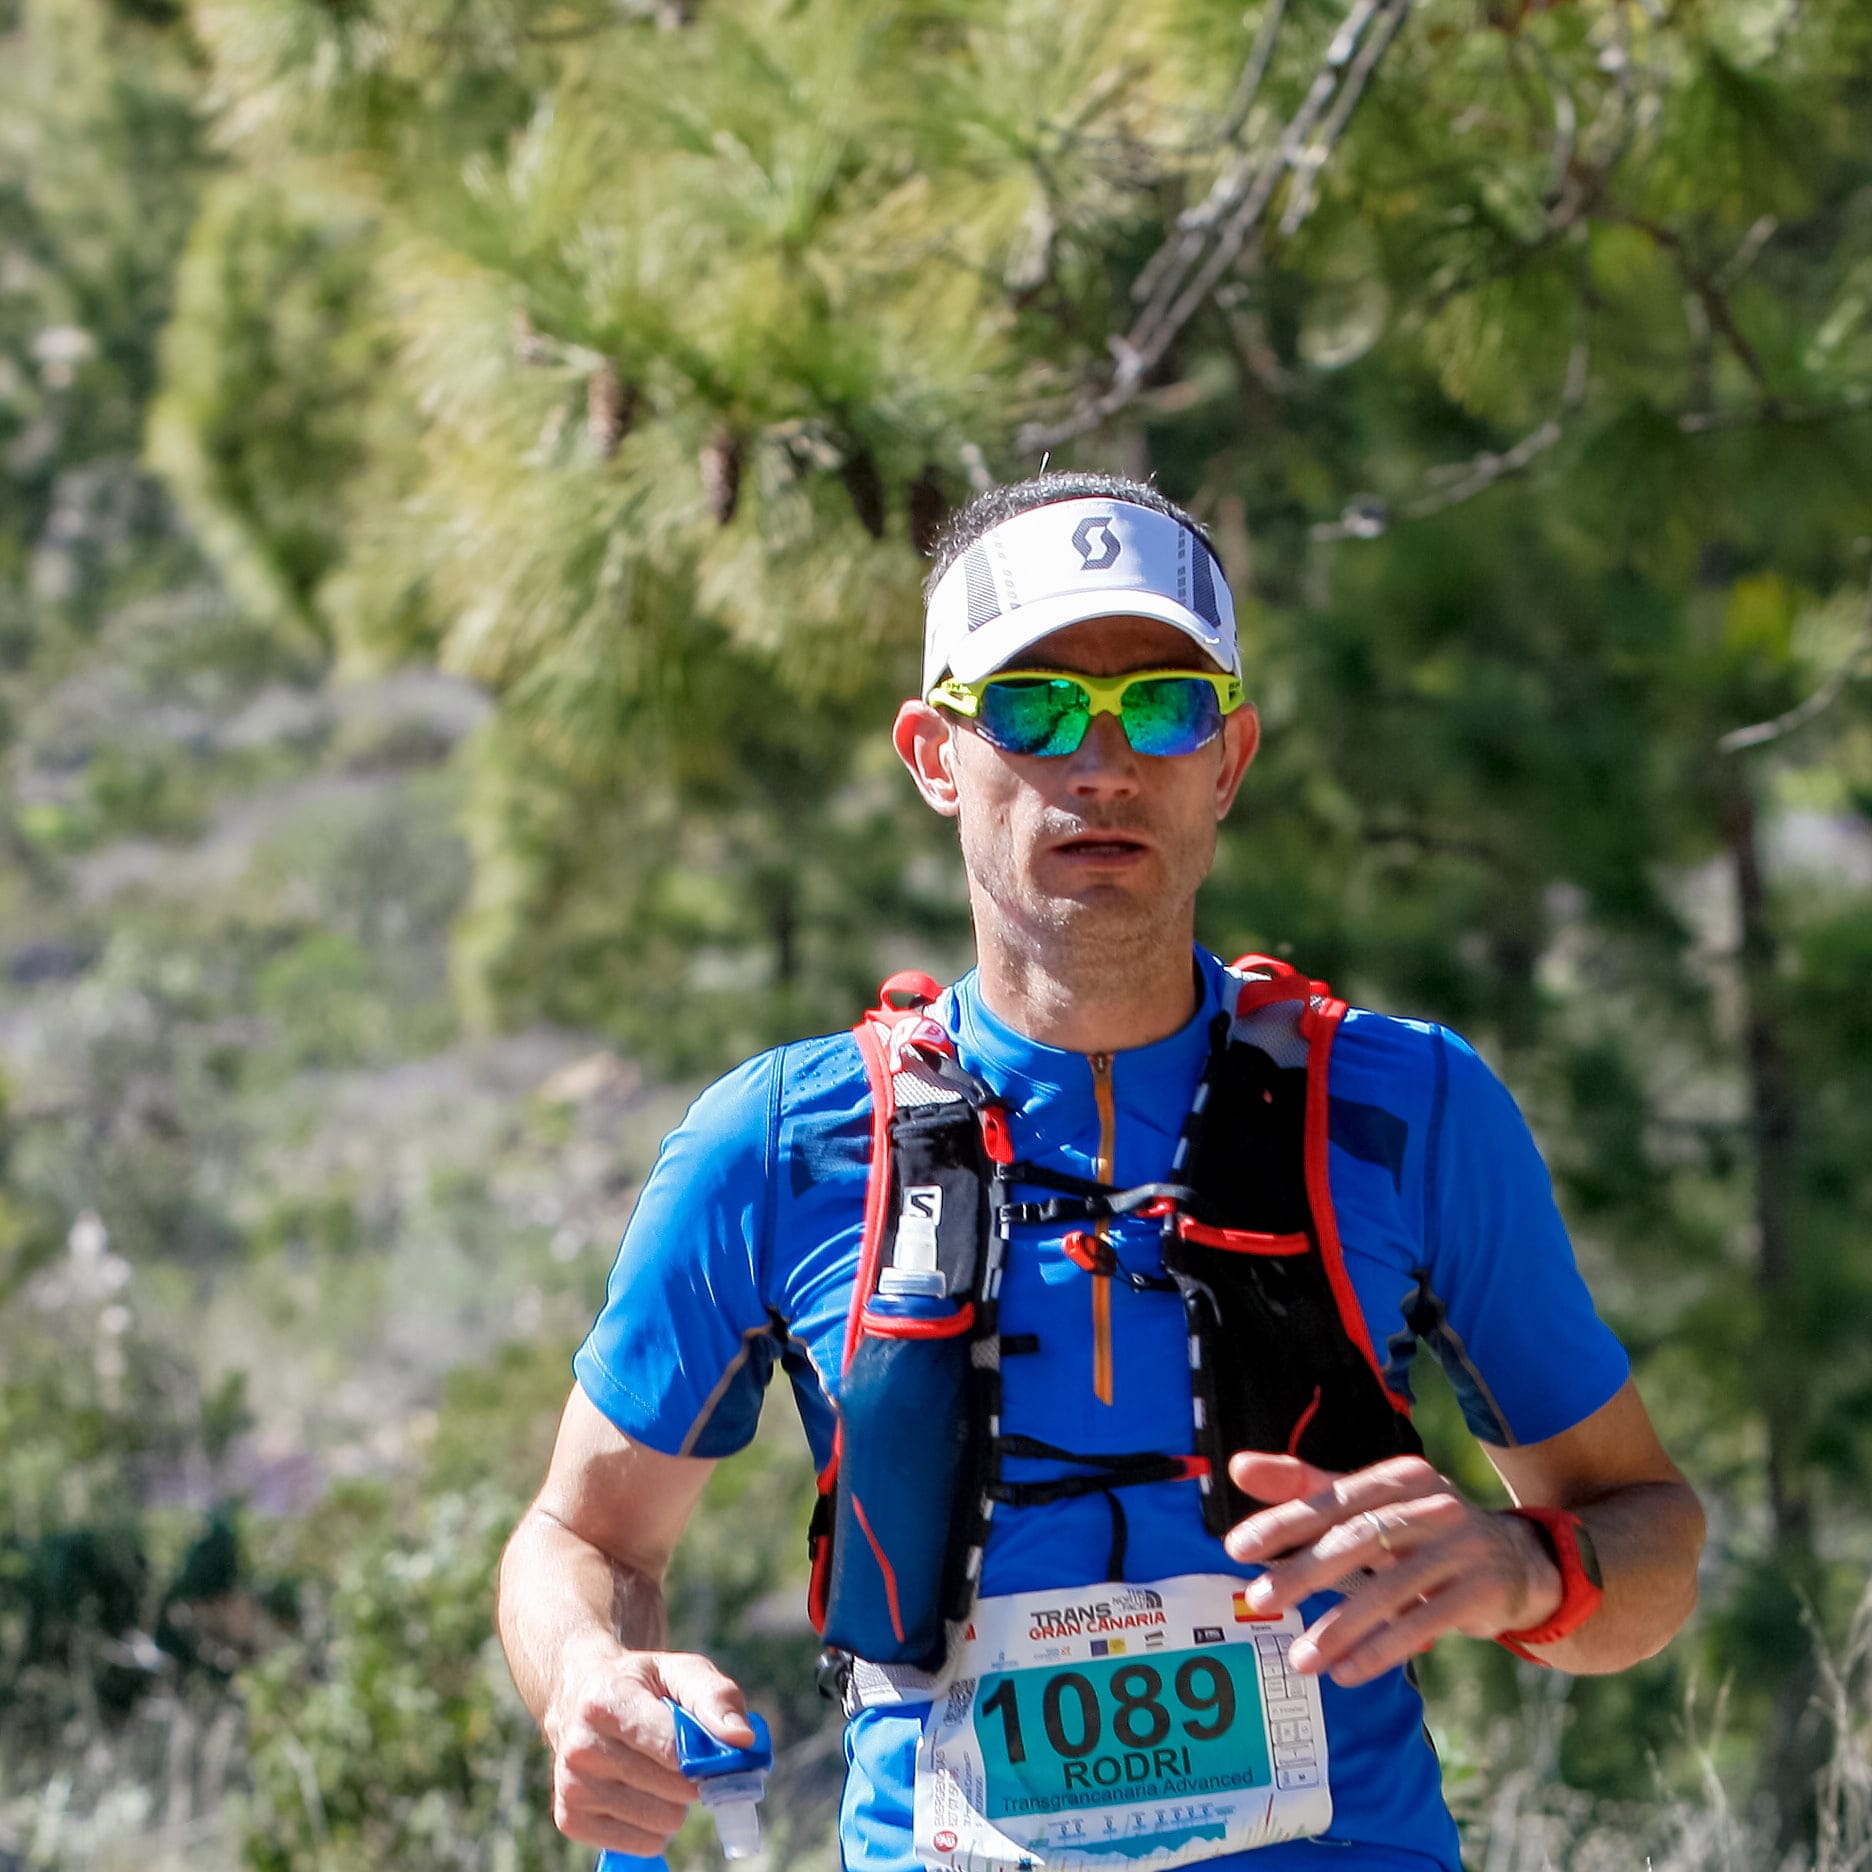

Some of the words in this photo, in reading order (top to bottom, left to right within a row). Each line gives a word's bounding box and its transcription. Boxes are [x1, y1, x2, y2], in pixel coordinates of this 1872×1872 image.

[1029, 1623, 1081, 1641] GRAN
[1087, 1611, 1167, 1633] CANARIA
[1031, 1602, 1111, 1628] TRANS
[982, 1656, 1236, 1764] 1089
[1063, 1746, 1192, 1790] RODRI
[1003, 1778, 1158, 1812] Transgrancanaria
[1162, 1769, 1254, 1794] Advanced
